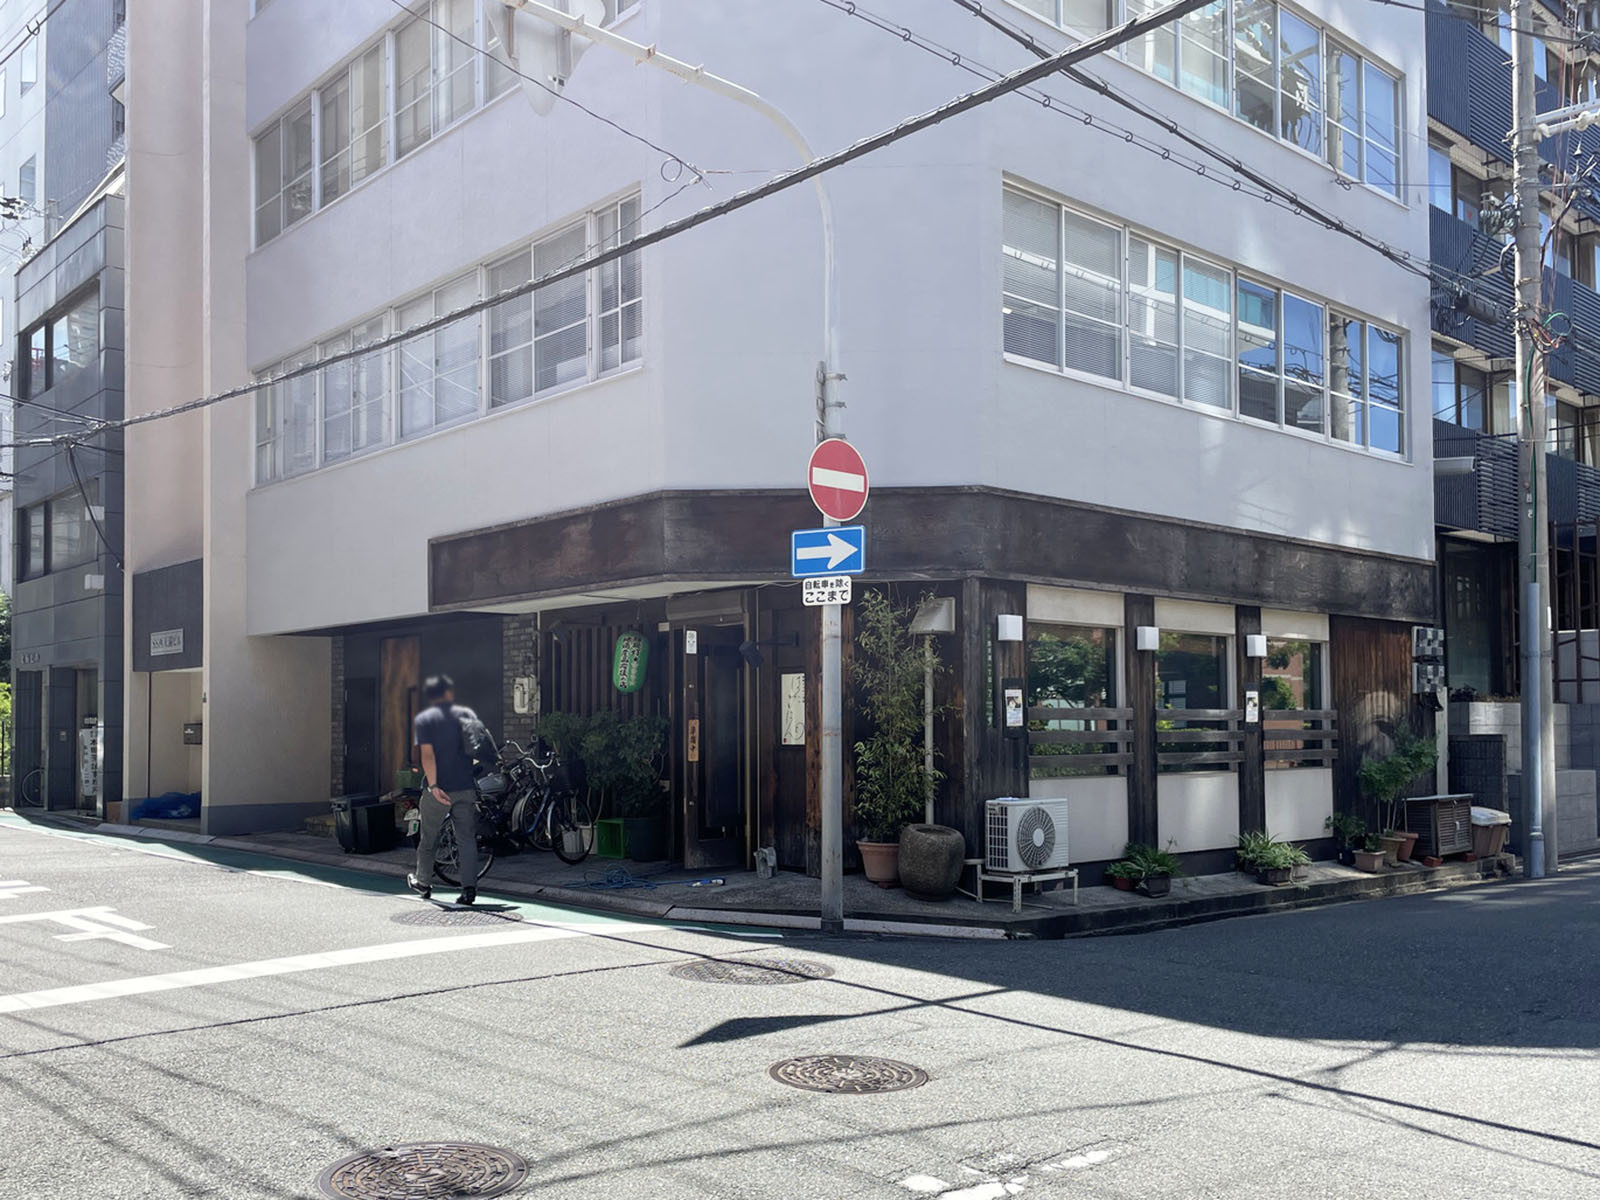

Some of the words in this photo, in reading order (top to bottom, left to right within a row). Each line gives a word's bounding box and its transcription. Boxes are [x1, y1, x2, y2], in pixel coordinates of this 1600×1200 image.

[805, 579, 849, 590] 自転車を除く
[805, 590, 849, 603] ここまで
